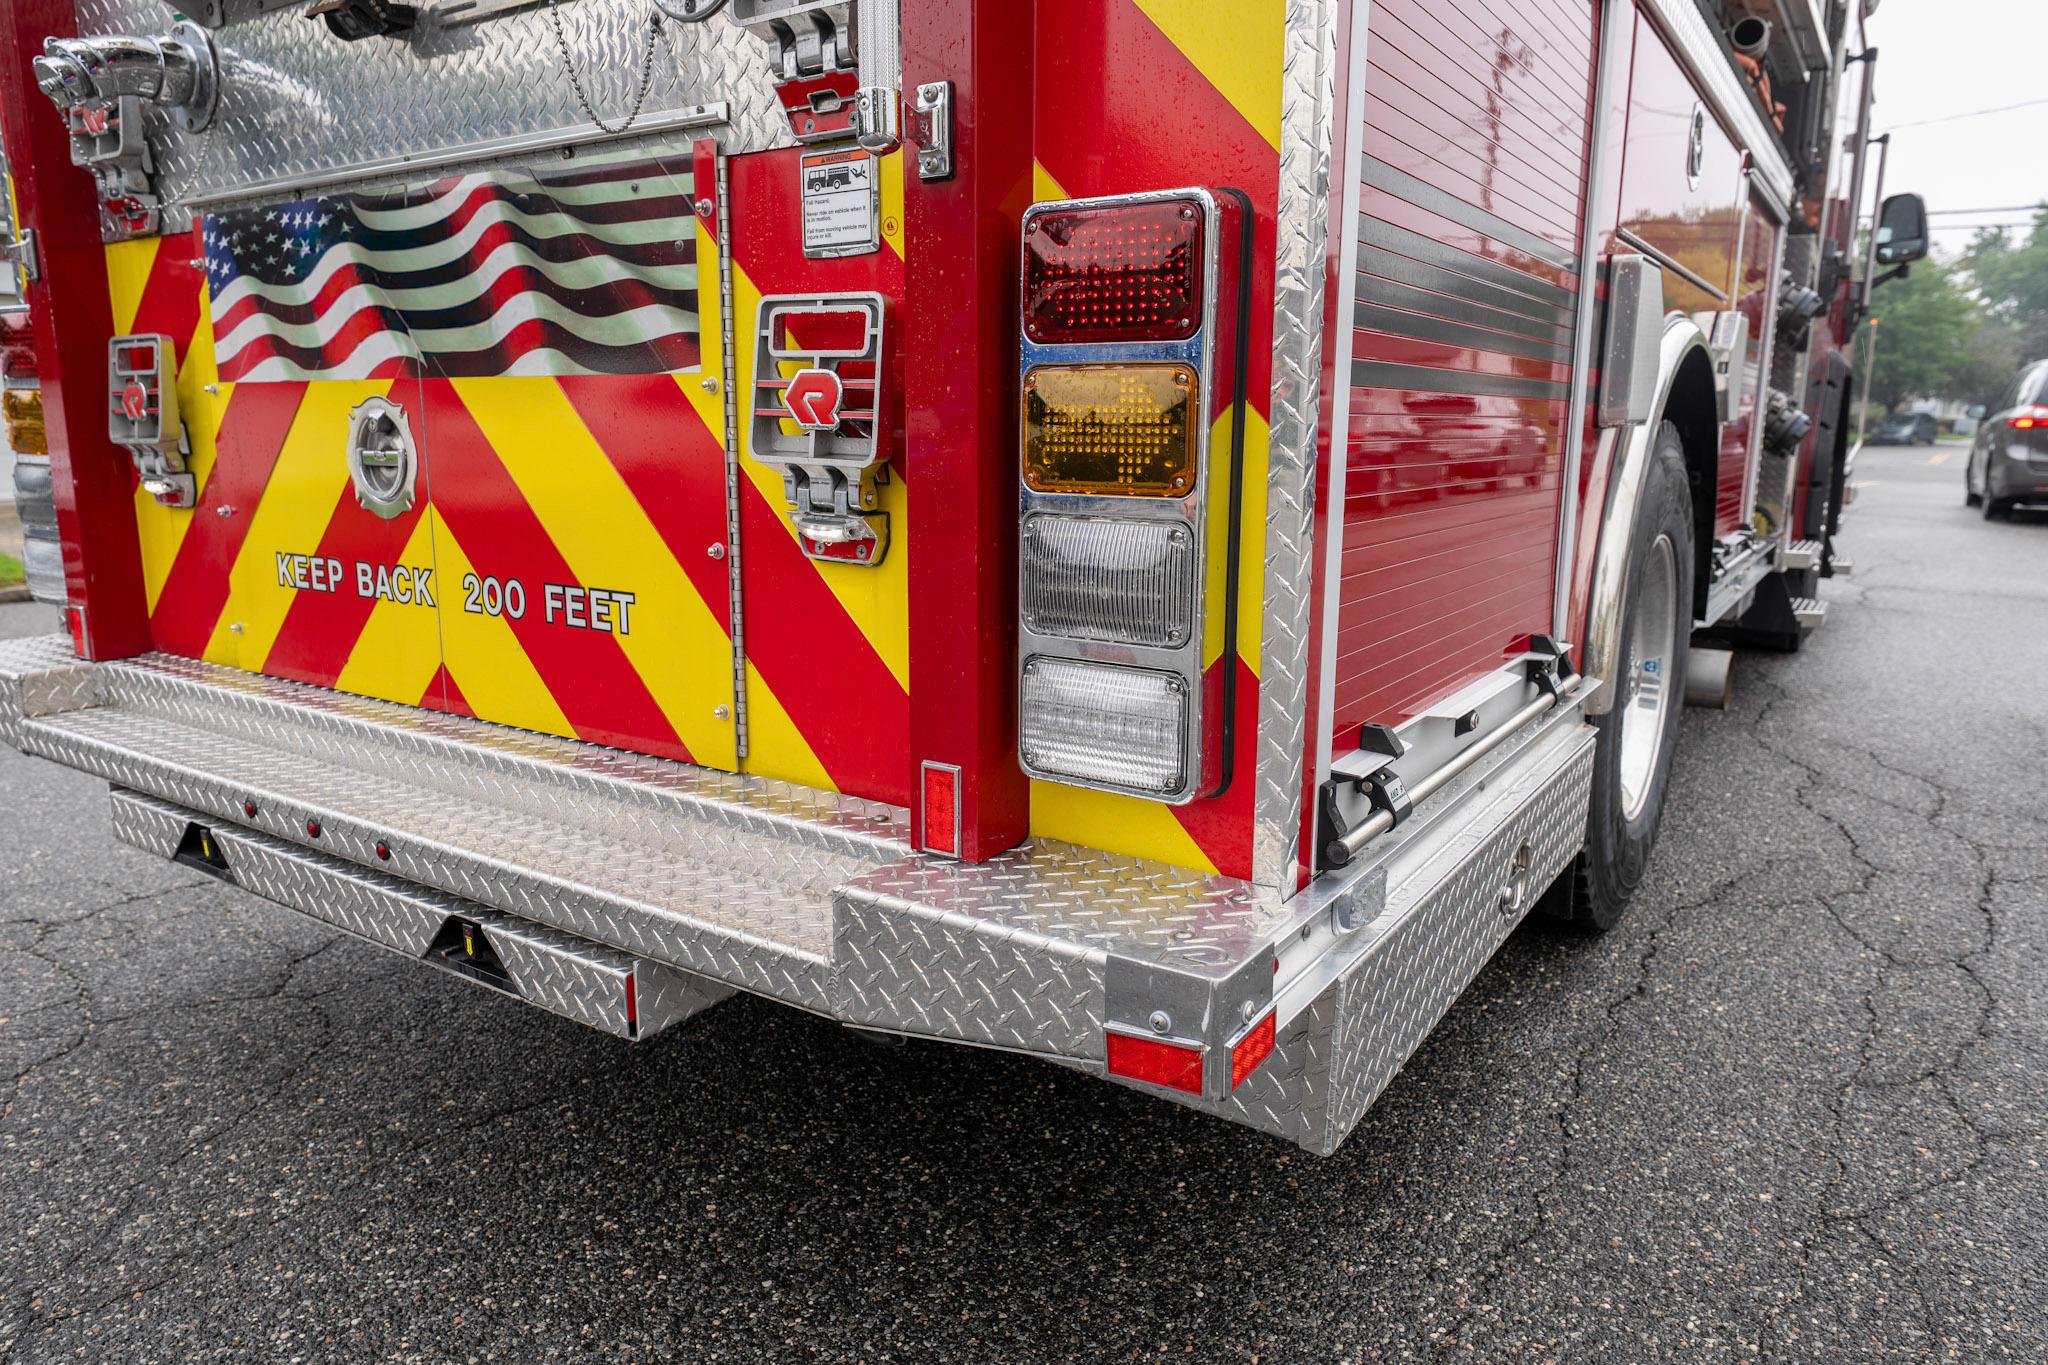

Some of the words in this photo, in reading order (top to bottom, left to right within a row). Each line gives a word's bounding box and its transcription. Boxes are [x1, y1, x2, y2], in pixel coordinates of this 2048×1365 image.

[825, 154, 851, 162] WARNING
[275, 551, 344, 593] KEEP
[355, 560, 436, 608] BACK
[462, 573, 527, 619] 200
[544, 582, 635, 635] FEET
